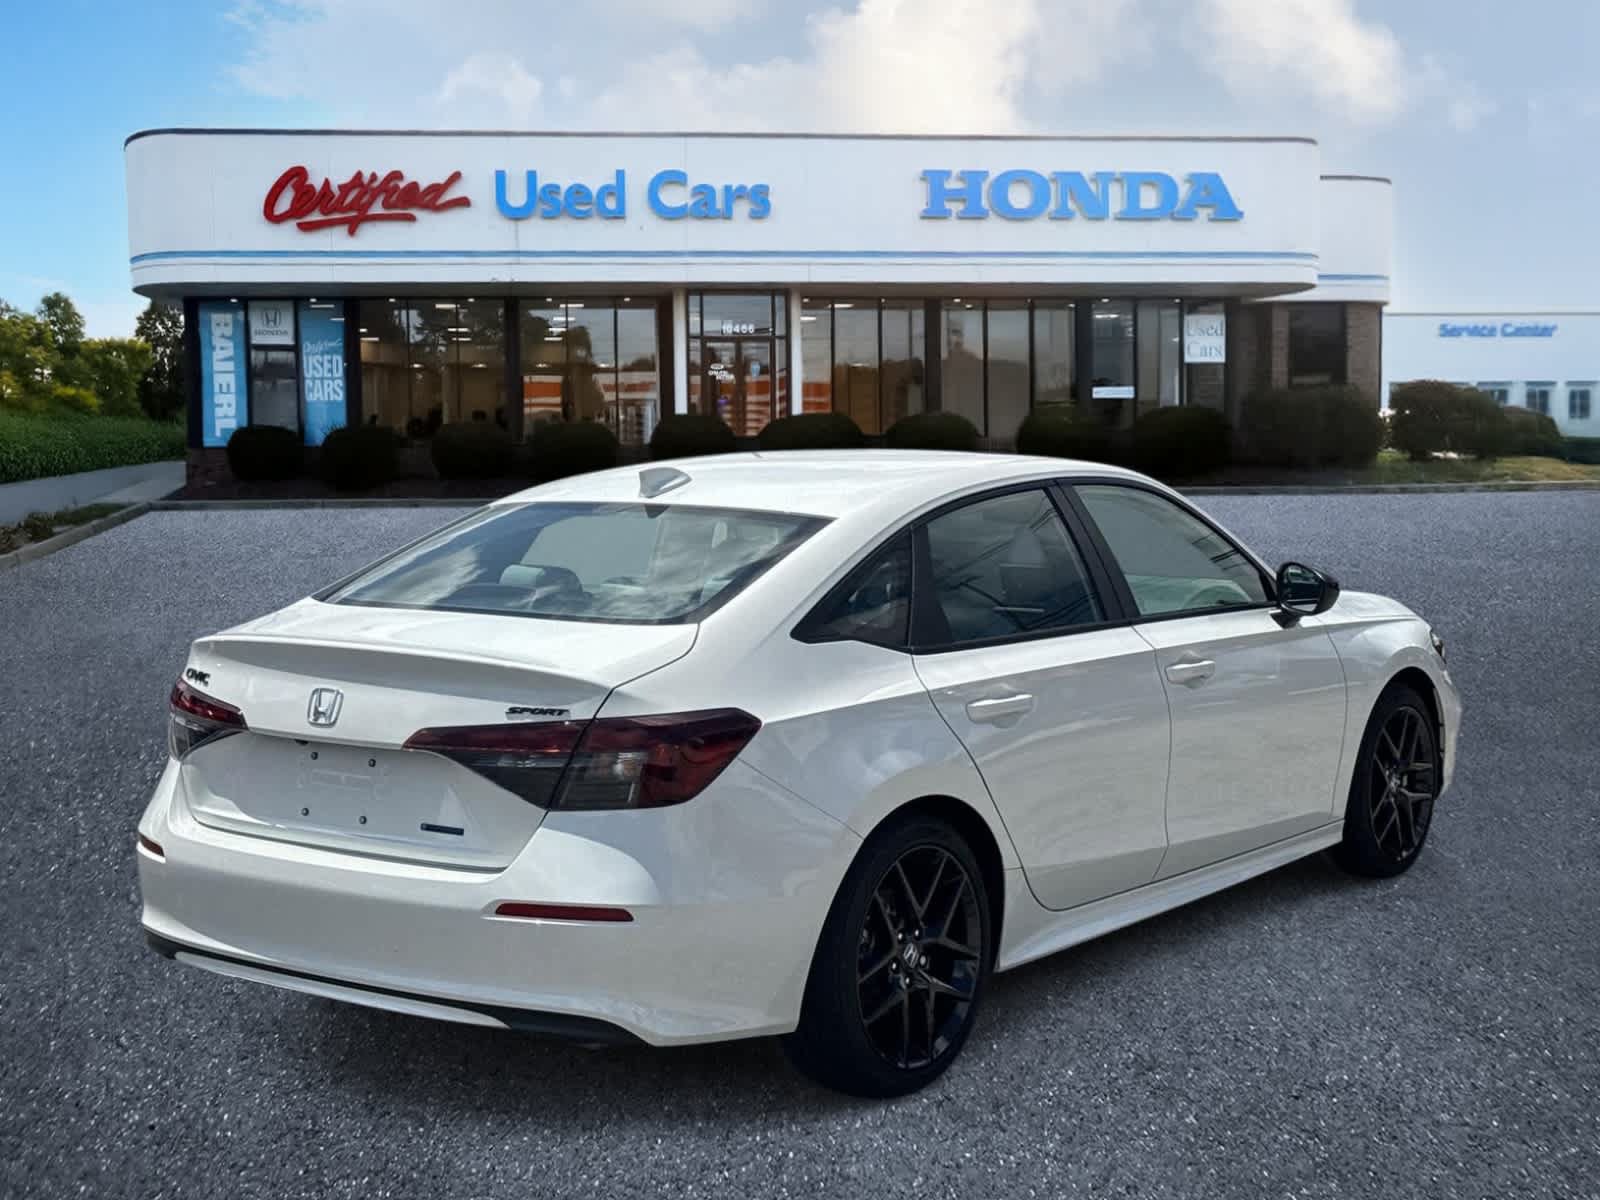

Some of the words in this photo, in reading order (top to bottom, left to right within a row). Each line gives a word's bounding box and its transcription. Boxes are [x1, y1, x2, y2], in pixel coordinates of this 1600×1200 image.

[264, 166, 471, 236] Certified
[495, 169, 625, 219] Used
[647, 169, 772, 219] Cars
[919, 169, 1244, 221] HONDA
[253, 329, 289, 337] HONDA
[1186, 319, 1224, 337] Used
[1439, 323, 1497, 338] Service
[1501, 323, 1558, 338] Center
[1186, 342, 1223, 358] Cars
[211, 313, 237, 437] BAIERL
[303, 355, 343, 378] USED
[304, 379, 343, 401] CARS
[506, 706, 569, 716] SPORT
